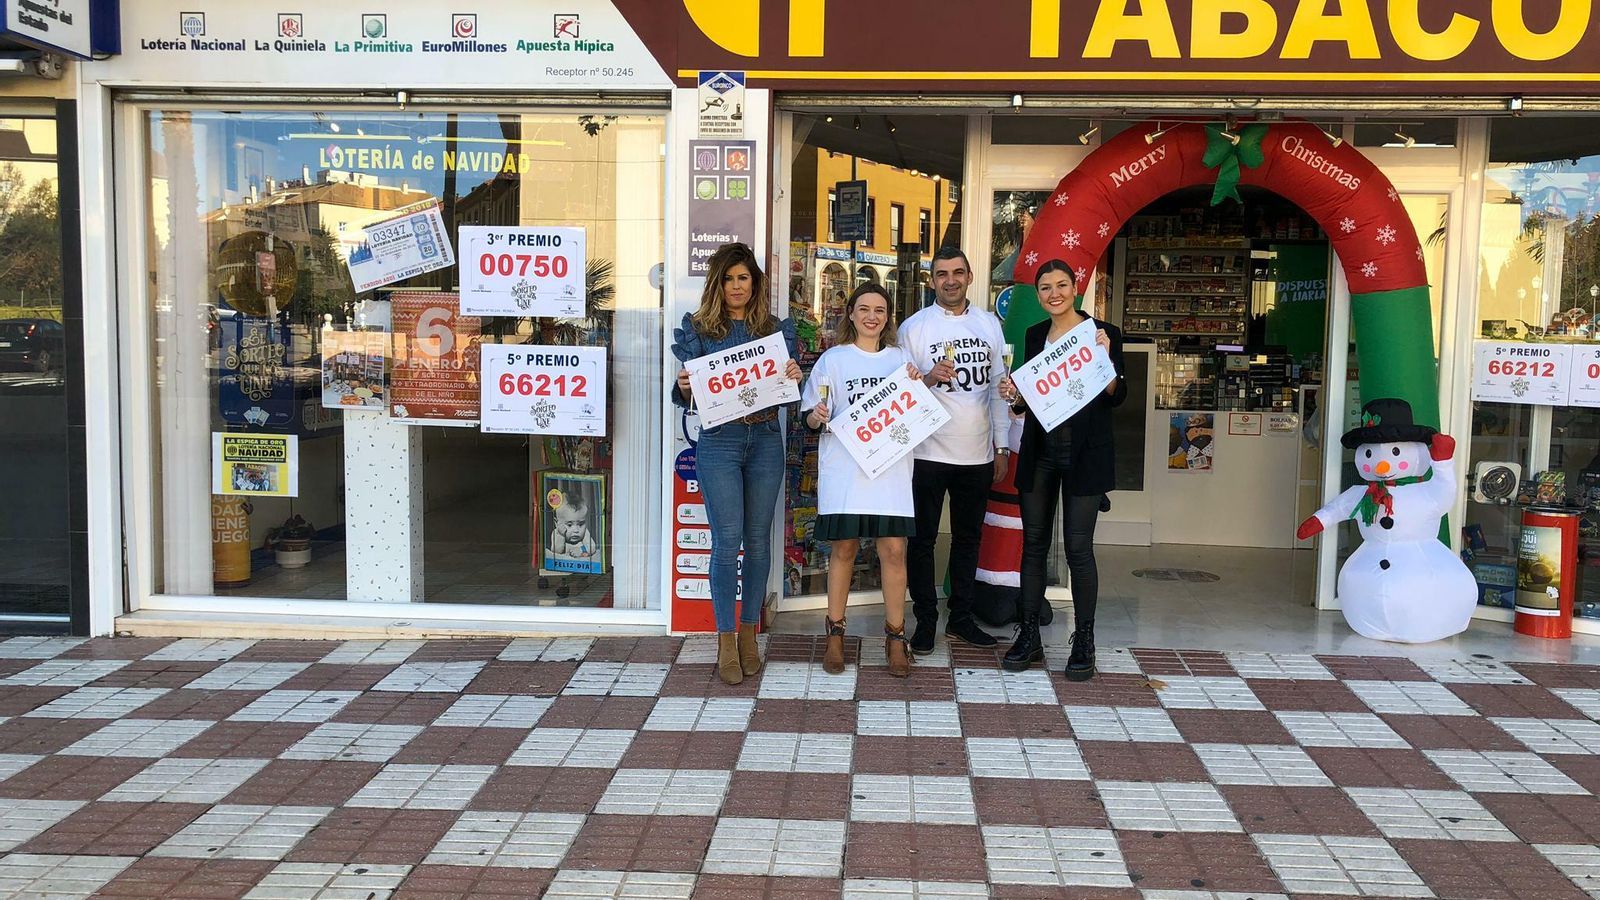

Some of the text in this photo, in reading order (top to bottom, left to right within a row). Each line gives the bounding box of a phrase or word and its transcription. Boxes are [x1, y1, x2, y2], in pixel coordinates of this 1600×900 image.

[19, 11, 48, 32] Estado
[60, 10, 72, 25] del
[141, 38, 246, 51] Lotería Nacional
[255, 40, 326, 52] La Quiniela
[334, 41, 413, 53] La Primitiva
[421, 41, 508, 53] EuroMillones
[516, 39, 614, 54] Apuesta Hípica
[545, 67, 587, 78] Receptor
[602, 67, 634, 77] 50.245
[320, 144, 531, 174] LOTERÍA de NAVIDAD
[1109, 143, 1167, 188] Merry
[1281, 135, 1361, 191] Christmas
[372, 224, 406, 243] 03347
[416, 223, 425, 231] 10
[487, 232, 561, 247] 3er PREMIO
[691, 232, 739, 243] Loterías y
[691, 247, 718, 258] Apue
[480, 253, 568, 278] 00750
[1280, 292, 1288, 302] A
[416, 306, 453, 357] 6
[225, 343, 286, 370] SORTEO
[723, 345, 766, 366] PREMIO
[1031, 335, 1078, 375] 3er PREMIO
[1510, 348, 1550, 357] PREMIO
[410, 357, 461, 370] ENERO
[526, 354, 580, 367] PREMIO
[1035, 346, 1093, 396] 00750
[1488, 360, 1555, 377] 66212
[707, 359, 778, 394] 66212
[404, 381, 465, 389] EXTRAORDINARIO
[499, 373, 587, 397] 66212
[861, 382, 898, 413] PREMIO
[856, 391, 918, 443] 66212
[238, 449, 284, 458] NAVIDAD
[554, 561, 574, 569] FELIZ
